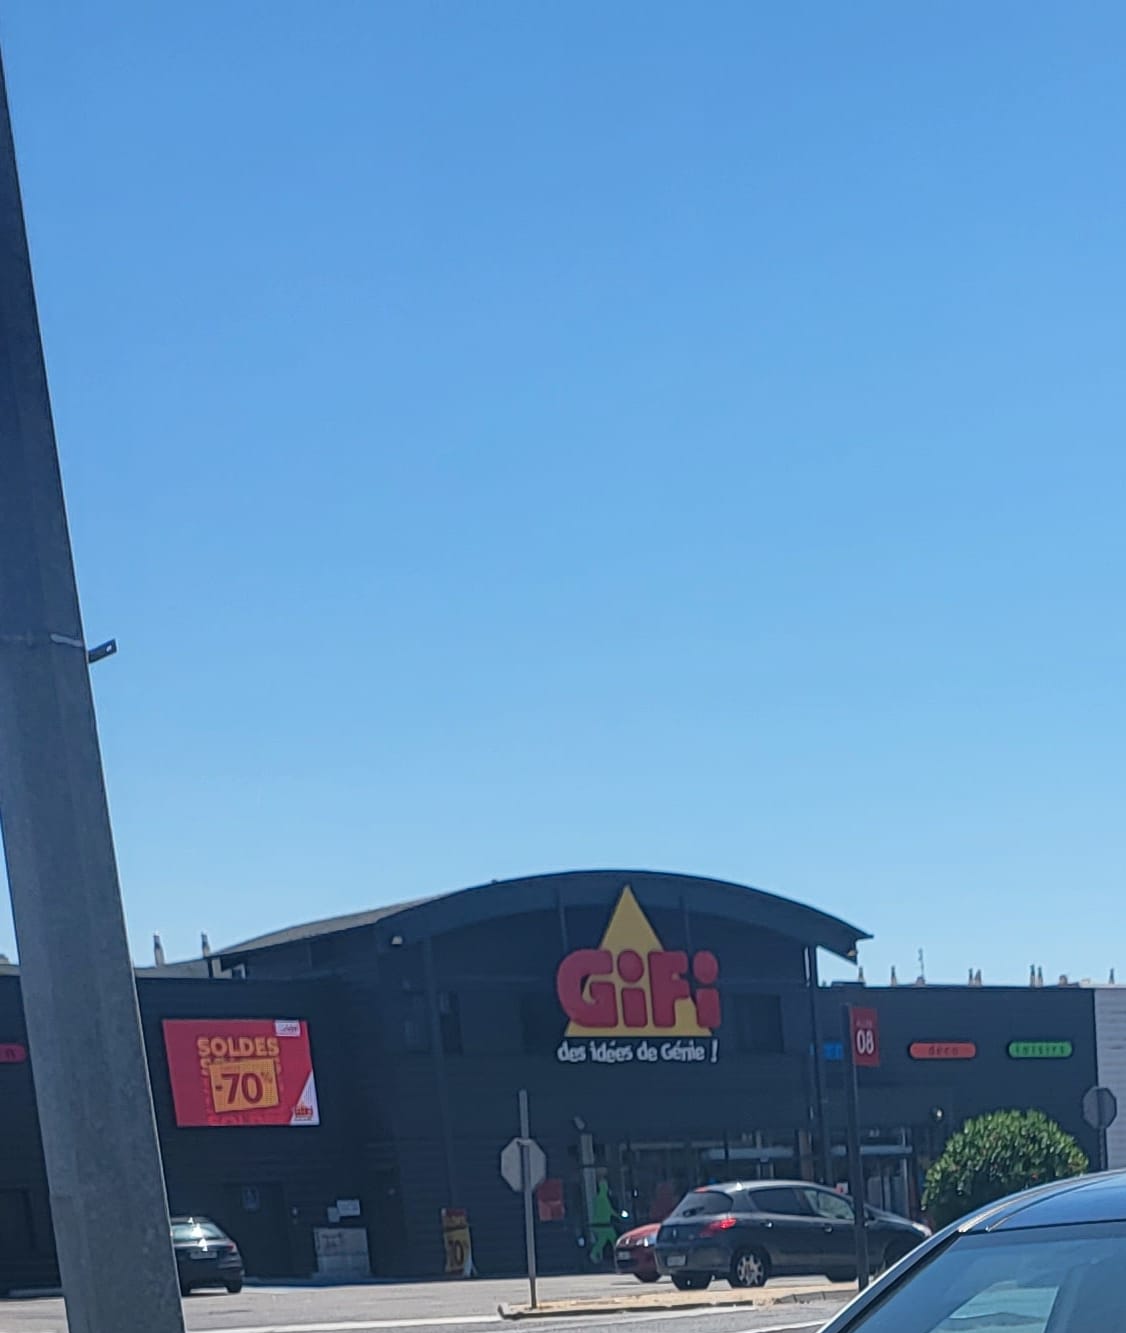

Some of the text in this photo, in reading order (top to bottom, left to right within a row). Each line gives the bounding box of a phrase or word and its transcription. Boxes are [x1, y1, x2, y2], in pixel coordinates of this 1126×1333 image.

[197, 1036, 280, 1057] SOLDES
[557, 1040, 586, 1062] des
[590, 1039, 633, 1063] idées
[637, 1041, 658, 1062] de
[660, 1039, 705, 1062] Génie
[855, 1029, 875, 1055] 08
